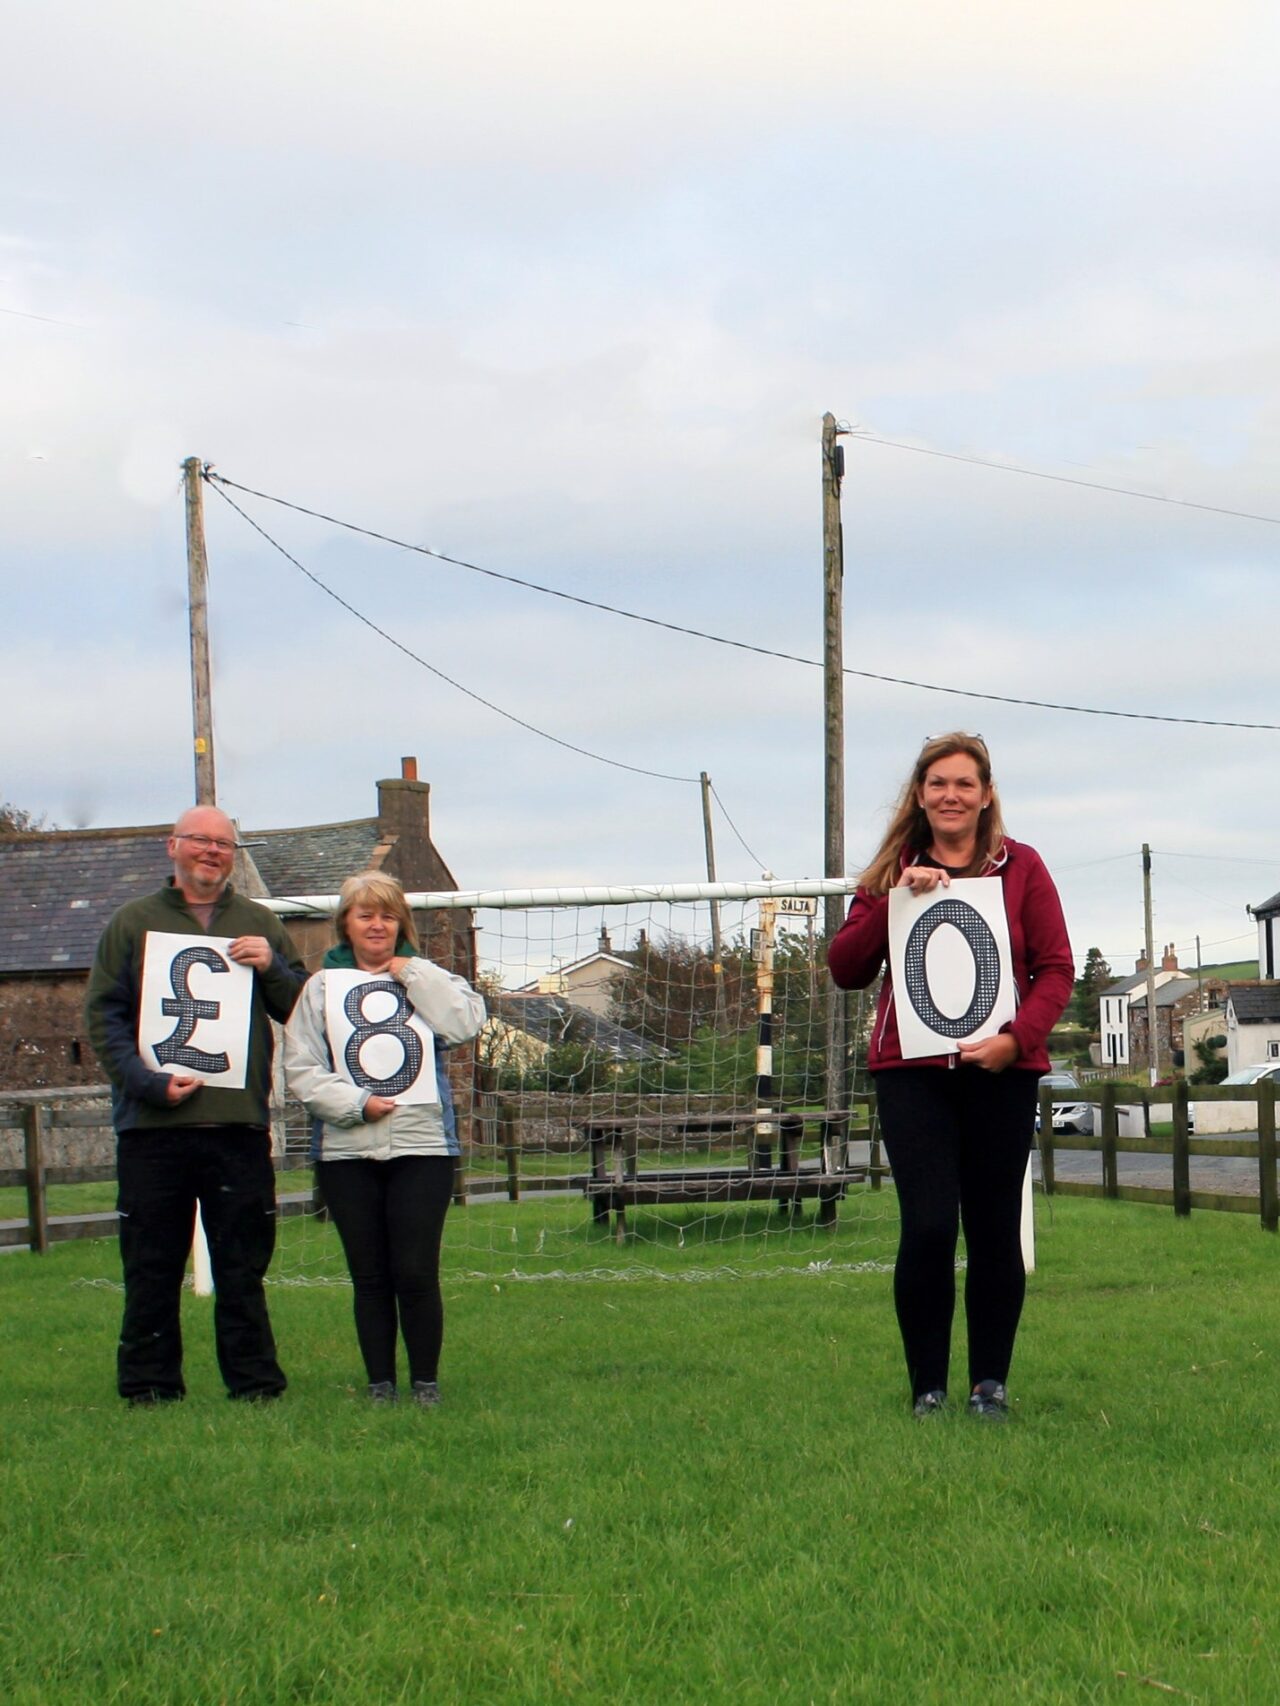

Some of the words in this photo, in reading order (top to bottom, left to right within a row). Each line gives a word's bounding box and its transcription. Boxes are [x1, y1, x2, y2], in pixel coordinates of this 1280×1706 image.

[781, 899, 810, 911] SALTA
[151, 946, 231, 1074] £
[344, 979, 424, 1097] 8
